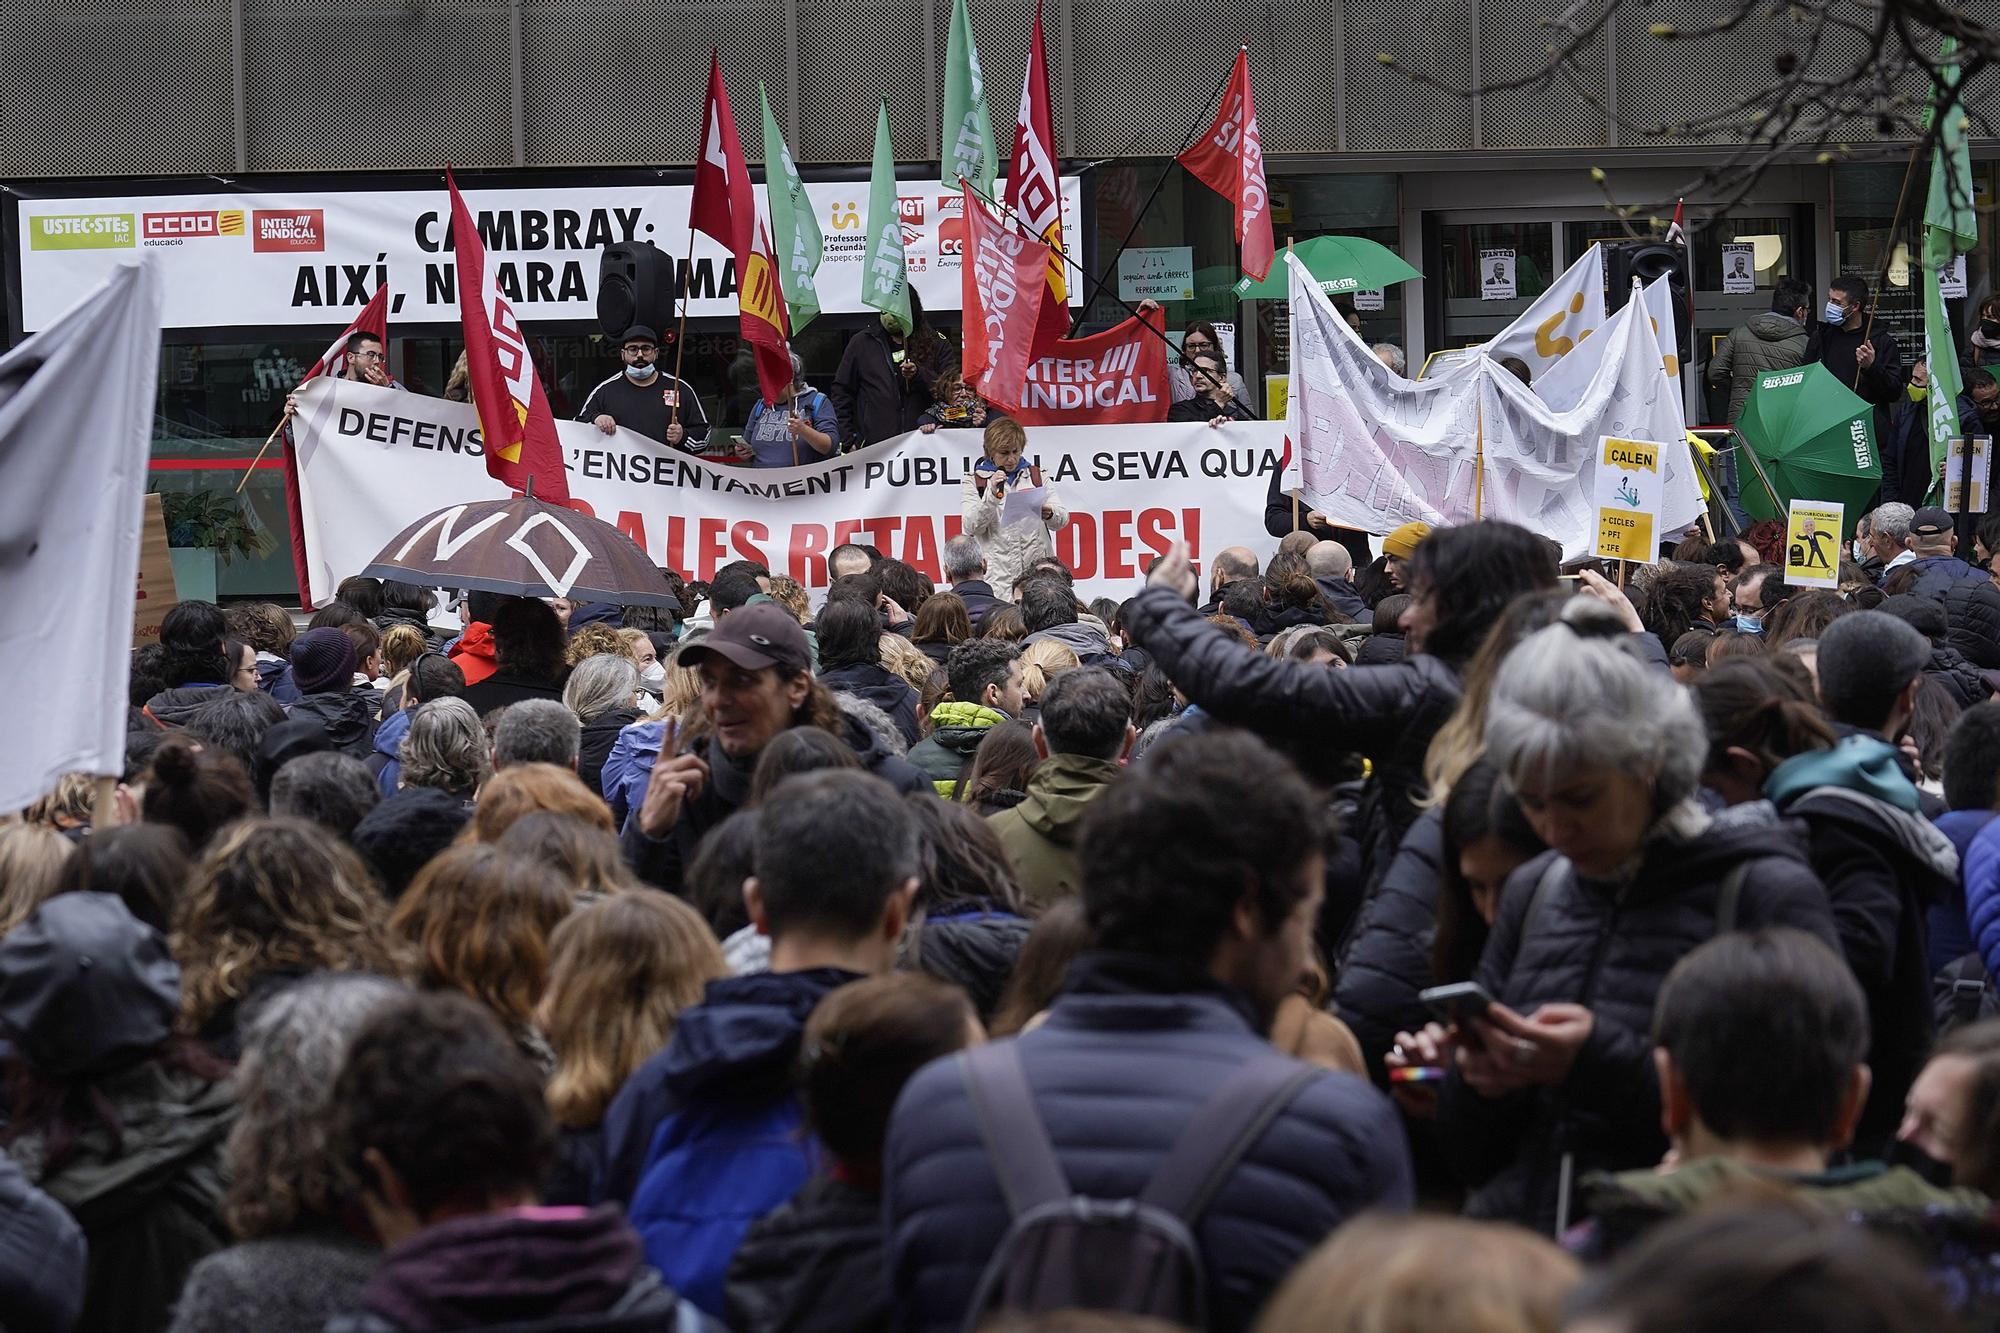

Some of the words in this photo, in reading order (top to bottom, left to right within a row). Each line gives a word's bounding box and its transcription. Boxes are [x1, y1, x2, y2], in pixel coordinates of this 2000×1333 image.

[147, 215, 213, 234] CCOO
[260, 218, 295, 229] INTER
[114, 233, 129, 243] IAC
[260, 227, 317, 239] SINDICAL
[824, 234, 867, 244] Professors
[143, 238, 184, 247] educació
[830, 243, 867, 252] Secundàr
[1481, 250, 1514, 259] WANTED
[291, 252, 406, 314] AIXÍ,
[498, 260, 589, 304] ARA
[676, 256, 741, 301] MA
[1319, 277, 1358, 291] STEC·STEs
[1027, 356, 1097, 384] NTER
[1020, 374, 1158, 410] INDICAL
[338, 406, 486, 457] DEFENS
[864, 451, 971, 490] PÚBLI
[1091, 448, 1189, 481] SEVA
[1199, 446, 1283, 478] QUA
[1955, 446, 1981, 455] CAEN
[1611, 449, 1653, 466] CALEN
[1608, 516, 1636, 528] CICLES
[1607, 530, 1621, 540] PFI
[393, 504, 593, 598] NO
[666, 514, 769, 584] LES
[1606, 543, 1620, 553] IFE
